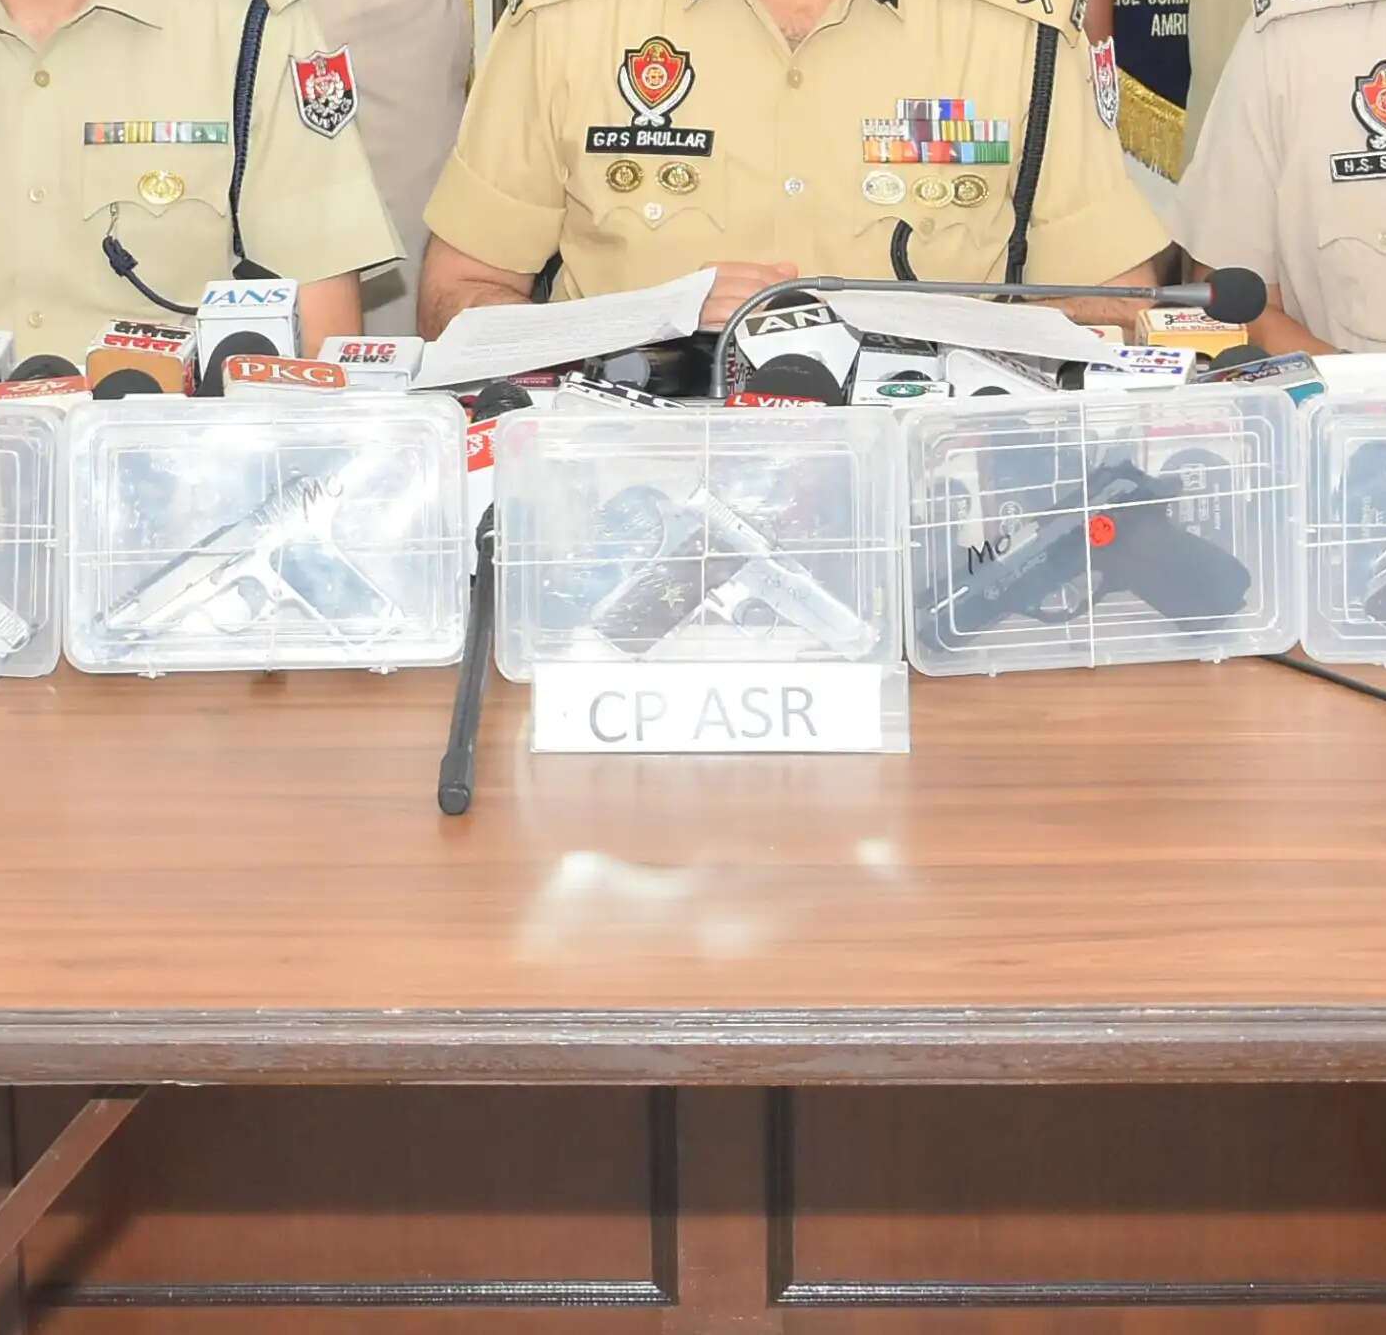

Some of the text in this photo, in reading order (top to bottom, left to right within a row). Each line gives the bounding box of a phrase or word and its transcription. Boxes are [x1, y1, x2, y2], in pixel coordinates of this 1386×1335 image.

[1151, 13, 1187, 37] AMRI
[636, 131, 707, 148] BHULLAR
[203, 287, 290, 305] IANS
[342, 342, 397, 356] GTC
[339, 354, 390, 364] NEWS
[239, 361, 334, 384] PKG
[589, 686, 817, 743] CP ASR
